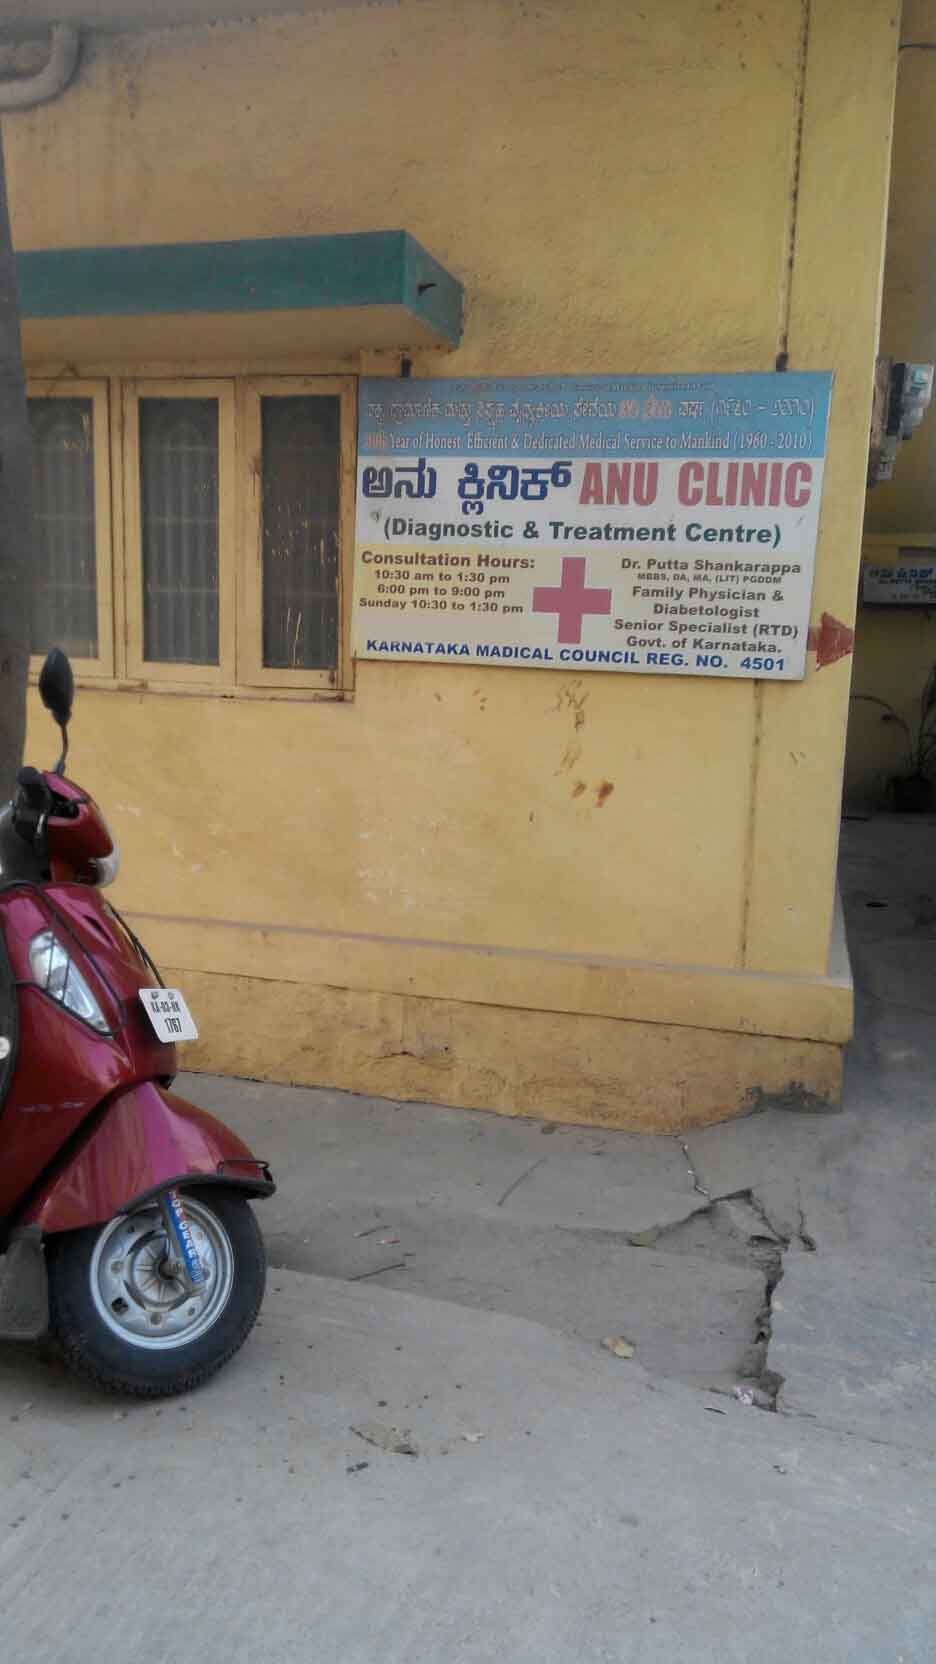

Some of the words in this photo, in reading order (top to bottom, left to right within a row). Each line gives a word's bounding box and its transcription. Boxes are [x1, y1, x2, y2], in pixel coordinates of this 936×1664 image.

[389, 432, 409, 449] Year
[413, 432, 425, 449] of
[511, 434, 519, 449] &
[523, 432, 575, 449] Dedicated
[578, 431, 620, 449] Medical
[624, 431, 663, 449] Service
[666, 433, 676, 449] to
[680, 431, 730, 449] Mankind
[362, 457, 437, 499] ಅನು
[457, 460, 573, 516] ಕ್ಲಿನಿಕ್
[580, 461, 659, 506] ANU
[677, 461, 813, 508] CLINIC
[384, 518, 513, 540] (Diagnostic
[523, 521, 539, 539] &
[549, 520, 676, 542] Treatment
[685, 523, 781, 549] Centre)
[362, 551, 470, 567] Consultation
[477, 554, 535, 569] Hours:
[621, 558, 640, 569] Dr.
[647, 558, 689, 571] Putta
[694, 559, 801, 575] Shankarappa
[374, 570, 410, 580] 10:30
[414, 573, 434, 581] am
[439, 572, 452, 582] to
[457, 573, 485, 583] 1:30
[489, 575, 510, 585] pm
[377, 584, 405, 594] 6:00
[409, 586, 430, 597] pm
[434, 585, 447, 595] to
[452, 586, 480, 597] 9:00
[484, 589, 505, 600] pm
[632, 586, 684, 600] Family
[689, 587, 766, 602] Physician
[772, 590, 784, 601] &
[359, 598, 407, 610] Sunday
[411, 599, 447, 610] 10:30
[452, 601, 465, 611] to
[470, 602, 498, 612] 1:30
[502, 604, 524, 614] pm
[653, 603, 760, 620] Diabetologist
[614, 619, 664, 631] Senior
[668, 620, 748, 635] Specialist
[752, 623, 799, 639] (RTD)
[626, 636, 666, 648] Govt.
[671, 637, 688, 649] of
[692, 638, 782, 653] Karnataka.
[366, 639, 470, 656] KARNATAKA
[476, 644, 553, 661] MADICAL
[559, 649, 639, 664] COUNCIL
[646, 653, 688, 666] REG.
[696, 655, 728, 668] NO.
[740, 656, 785, 671] 4501
[164, 1017, 182, 1033] 1767
